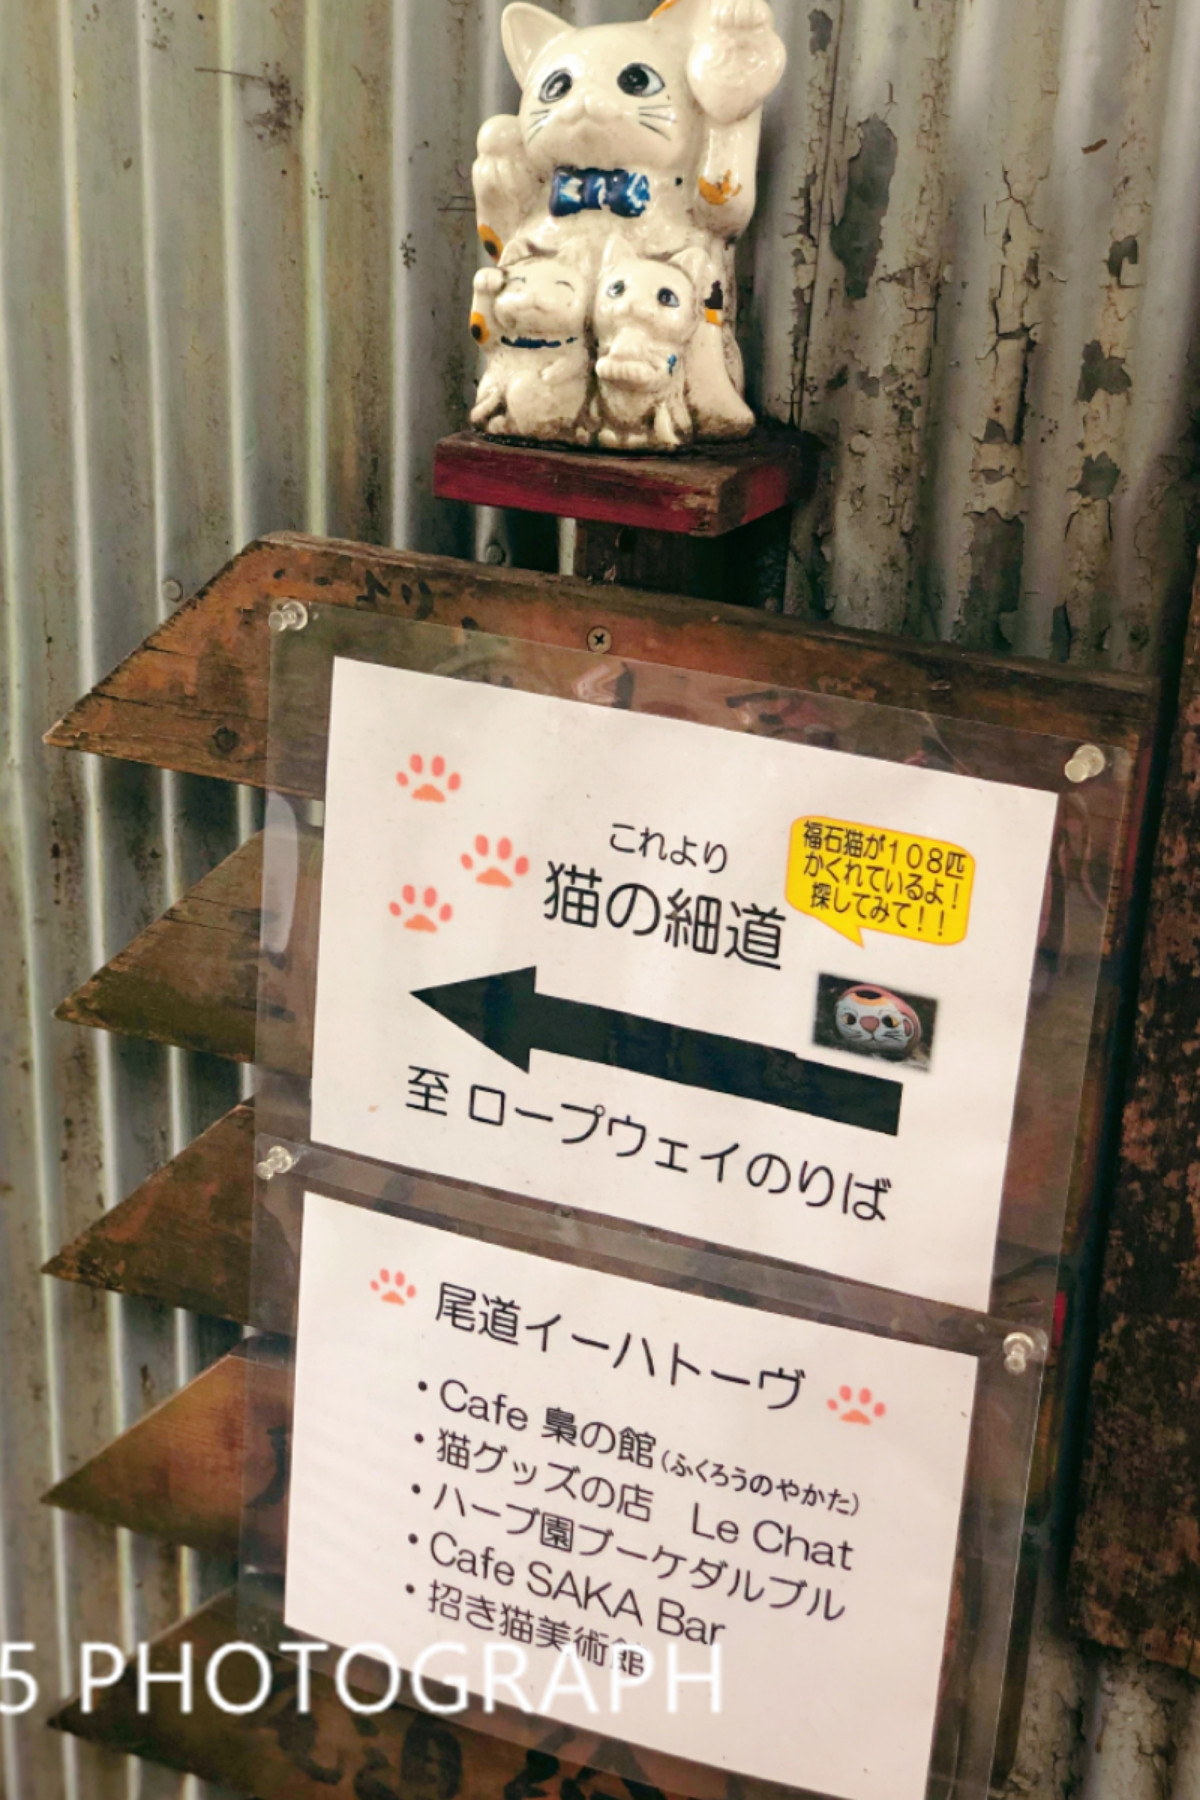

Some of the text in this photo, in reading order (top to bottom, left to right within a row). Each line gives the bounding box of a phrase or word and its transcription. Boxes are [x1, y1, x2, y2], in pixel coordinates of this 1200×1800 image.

[608, 820, 730, 875] これより
[543, 860, 786, 971] 猫の細道
[404, 1064, 893, 1224] 至 ロープウェイのりば
[434, 1281, 808, 1412] 尾道イーハトーヴ
[439, 1377, 531, 1433] Cafe
[433, 1482, 847, 1623] ハーブ園ブーケダルブル
[436, 1428, 855, 1571] 猫グッズの店 Le Chat
[429, 1531, 727, 1647] Cafe SAKA Bar
